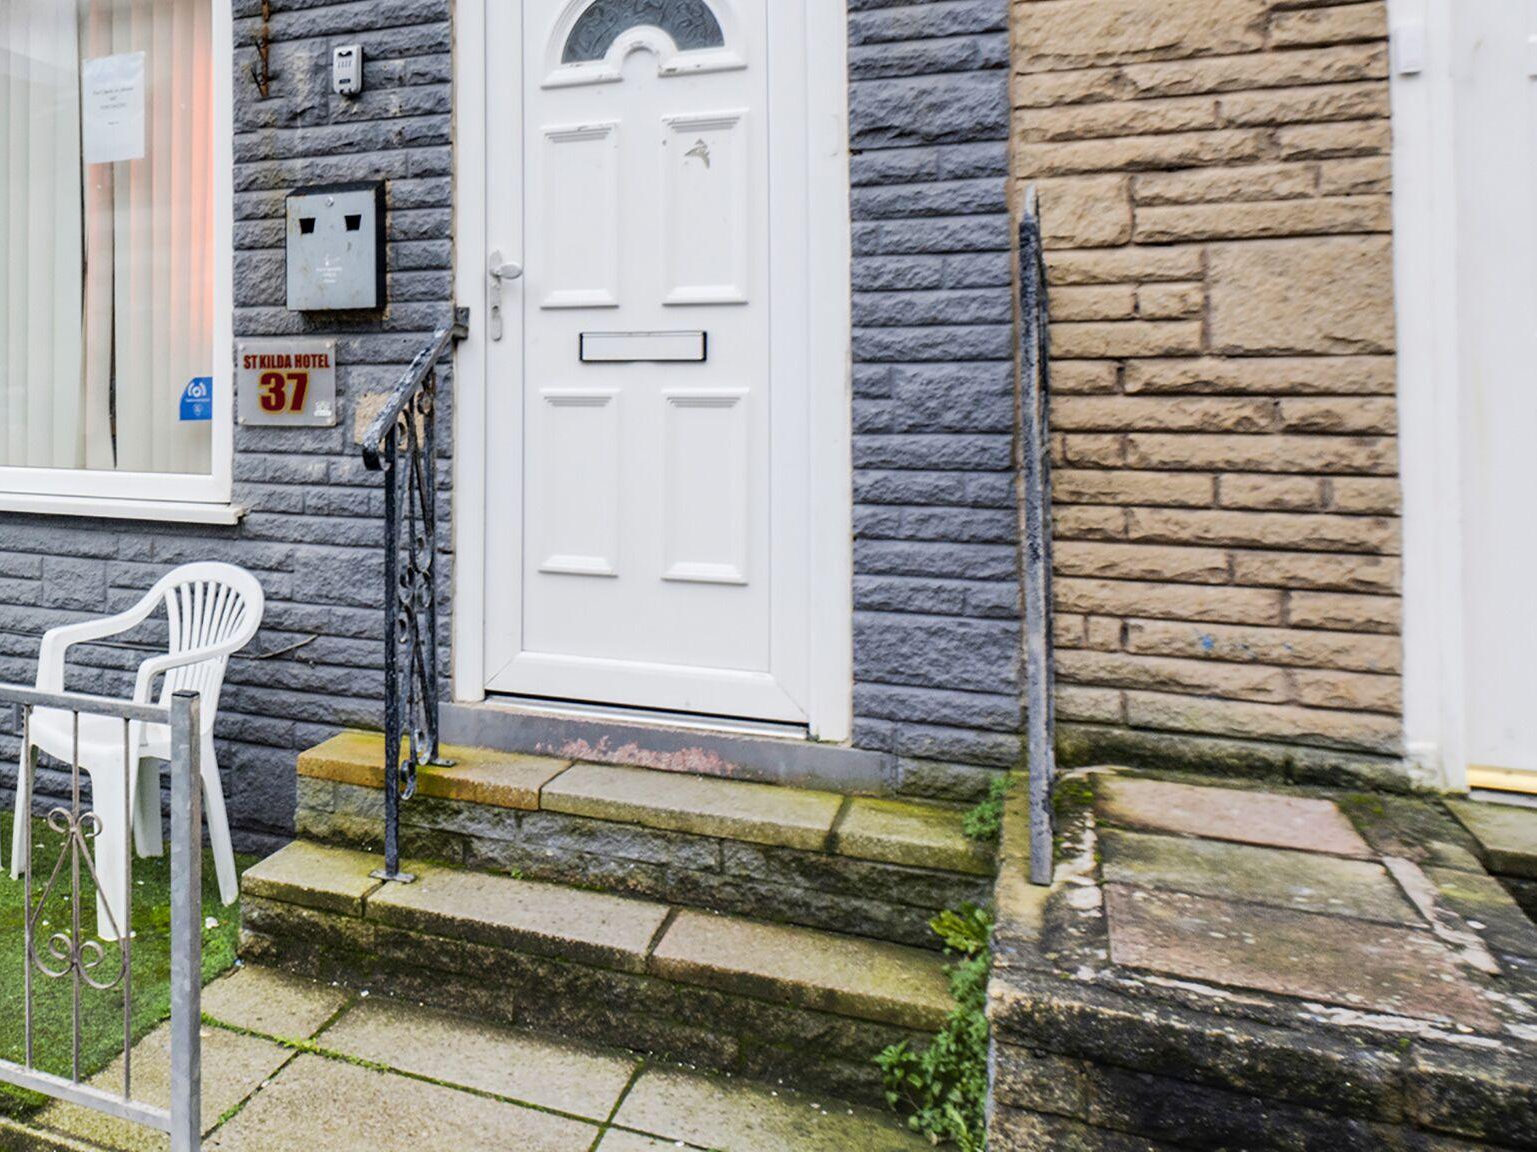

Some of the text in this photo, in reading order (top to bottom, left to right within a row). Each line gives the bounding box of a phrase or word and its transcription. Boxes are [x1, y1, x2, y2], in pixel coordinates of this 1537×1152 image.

[243, 353, 331, 370] ST KILDA HOTEL
[259, 371, 309, 413] 37
